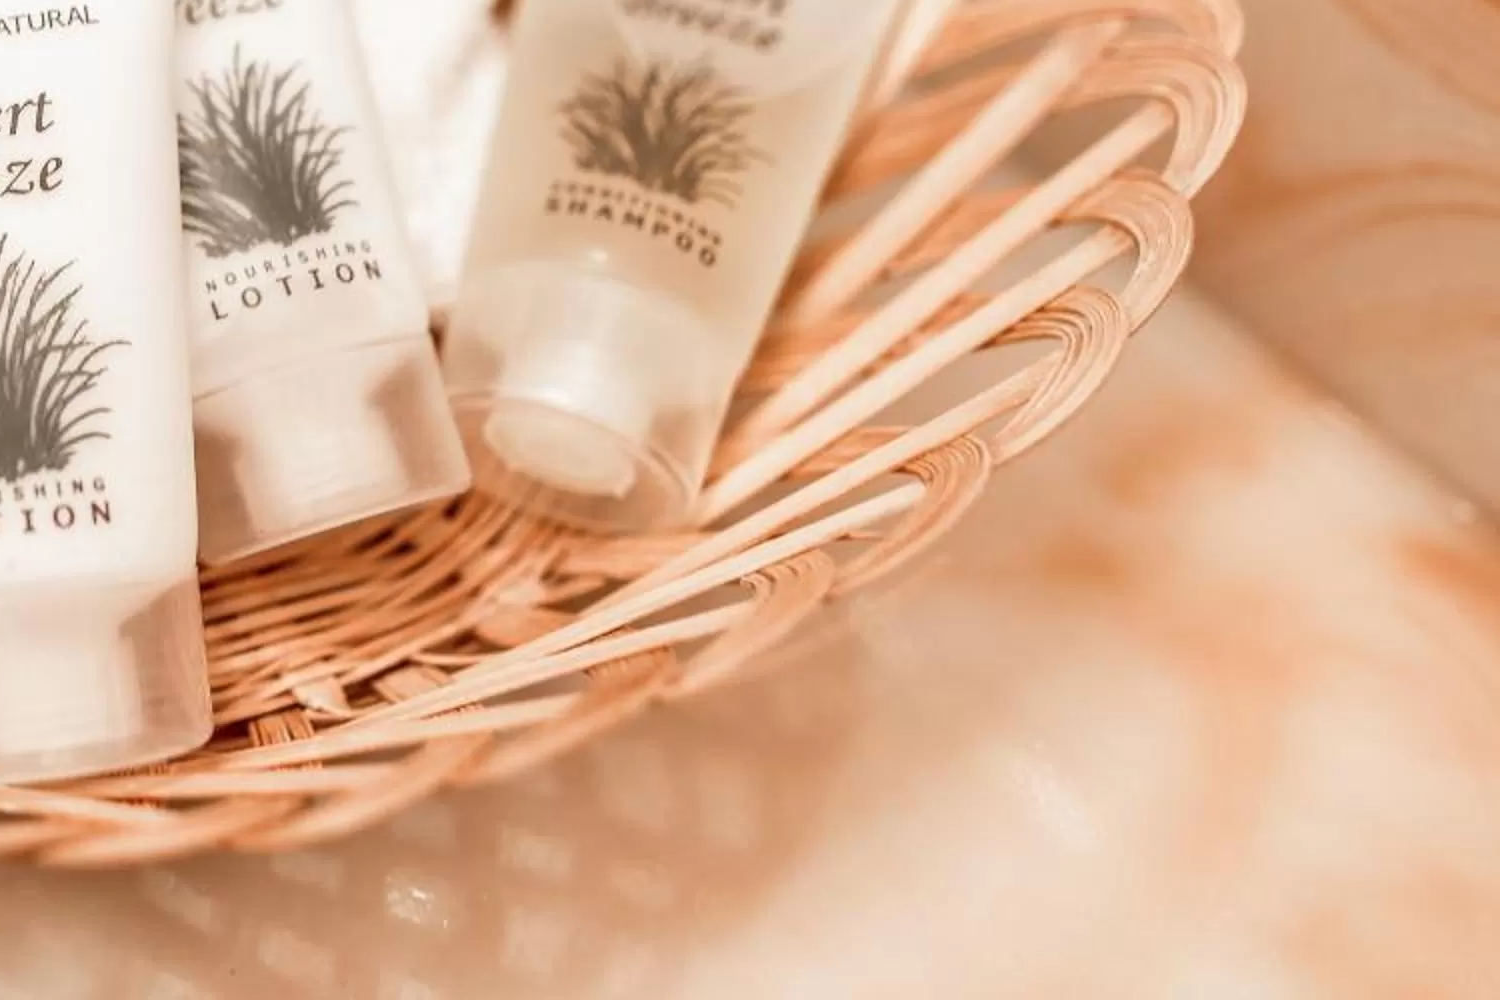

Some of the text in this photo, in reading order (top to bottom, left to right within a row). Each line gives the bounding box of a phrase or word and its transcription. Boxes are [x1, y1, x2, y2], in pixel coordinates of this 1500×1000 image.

[545, 197, 717, 268] SHAMPOO
[208, 239, 373, 294] NOURISHING
[210, 259, 383, 321] LOTION
